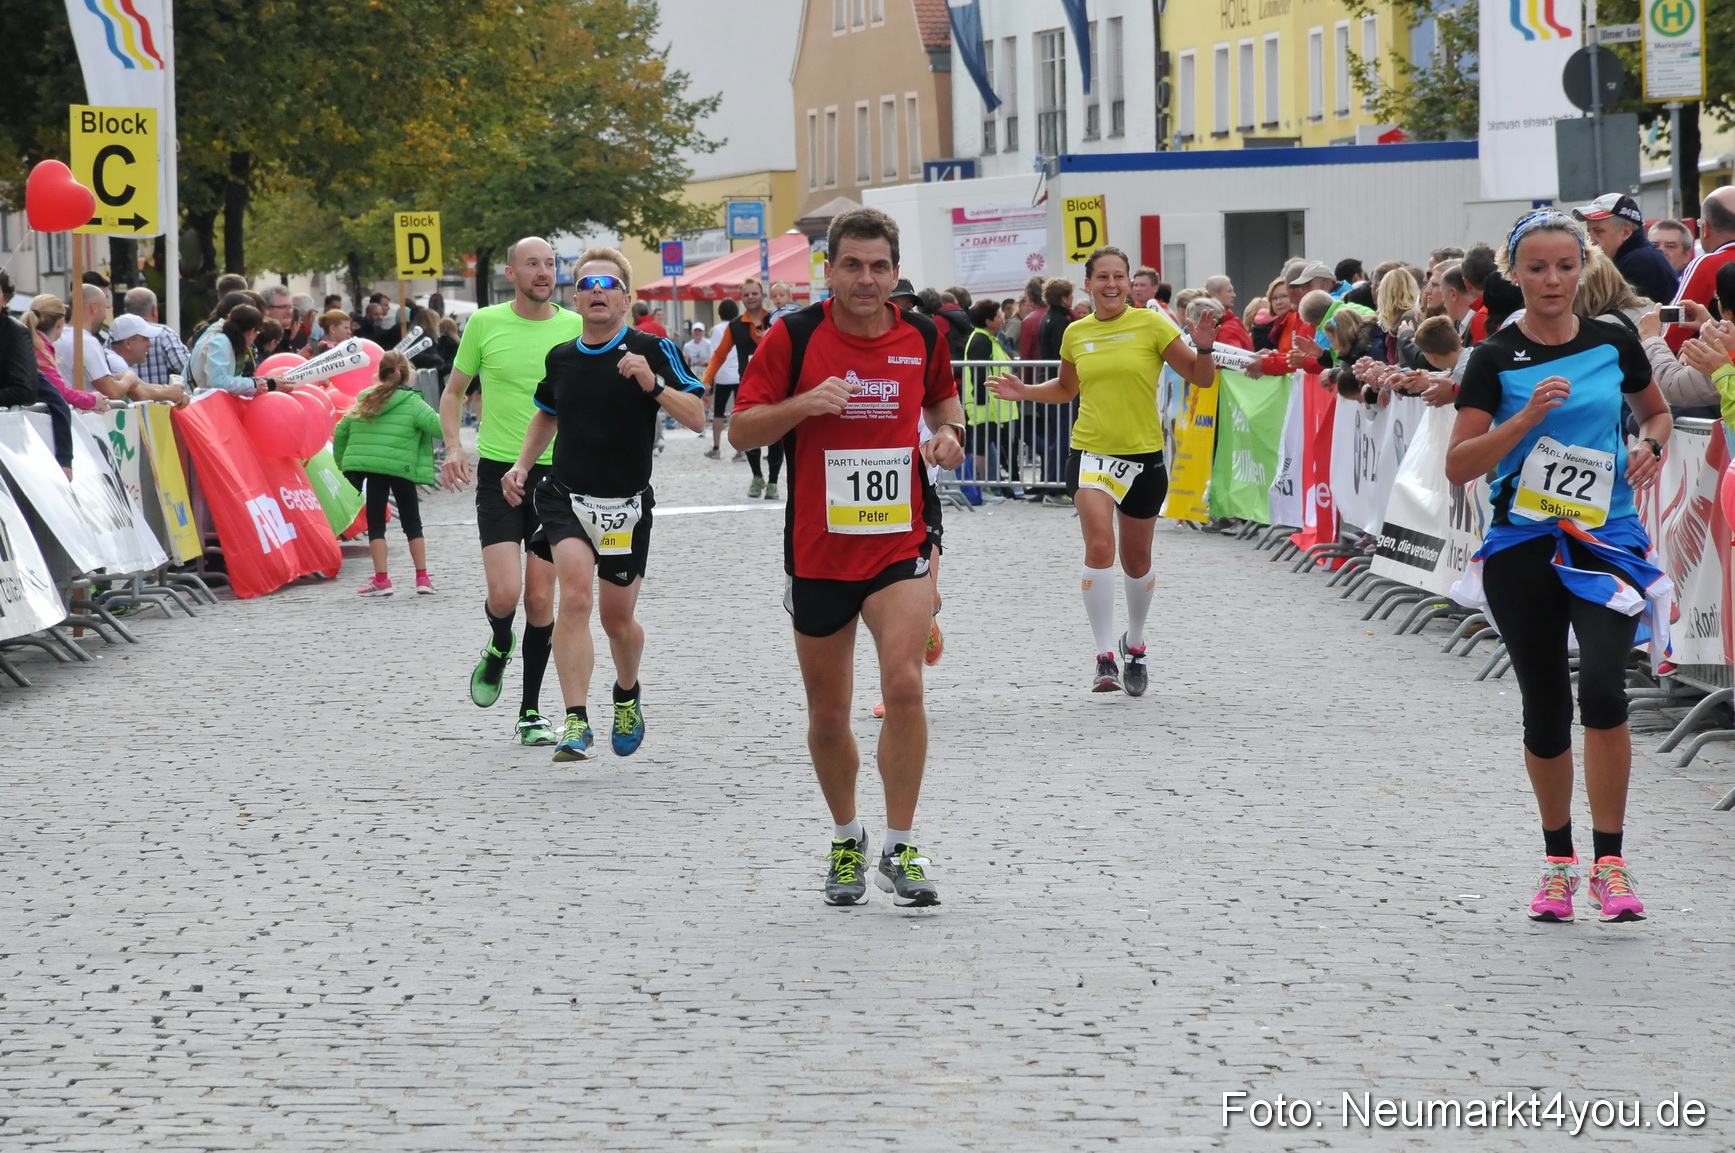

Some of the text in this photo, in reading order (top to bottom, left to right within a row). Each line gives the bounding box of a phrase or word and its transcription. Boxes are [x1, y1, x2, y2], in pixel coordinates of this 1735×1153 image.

[1600, 30, 1624, 40] Ulmer
[1654, 41, 1692, 50] Marktplatz
[81, 111, 148, 135] Block
[92, 144, 137, 208] C
[1066, 198, 1102, 212] Block
[400, 215, 435, 228] Block
[972, 234, 1019, 246] DAHMIT
[1074, 216, 1098, 249] D
[407, 232, 431, 265] D
[664, 266, 683, 275] TAXI
[860, 381, 898, 400] Helpi
[828, 458, 900, 467] PARTL Neumarkt
[1563, 452, 1603, 469] Neumarkt
[846, 469, 899, 502] 180
[1543, 461, 1597, 502] 122
[1540, 499, 1580, 518] Sabine
[859, 511, 889, 523] Peter
[1397, 538, 1411, 553] die
